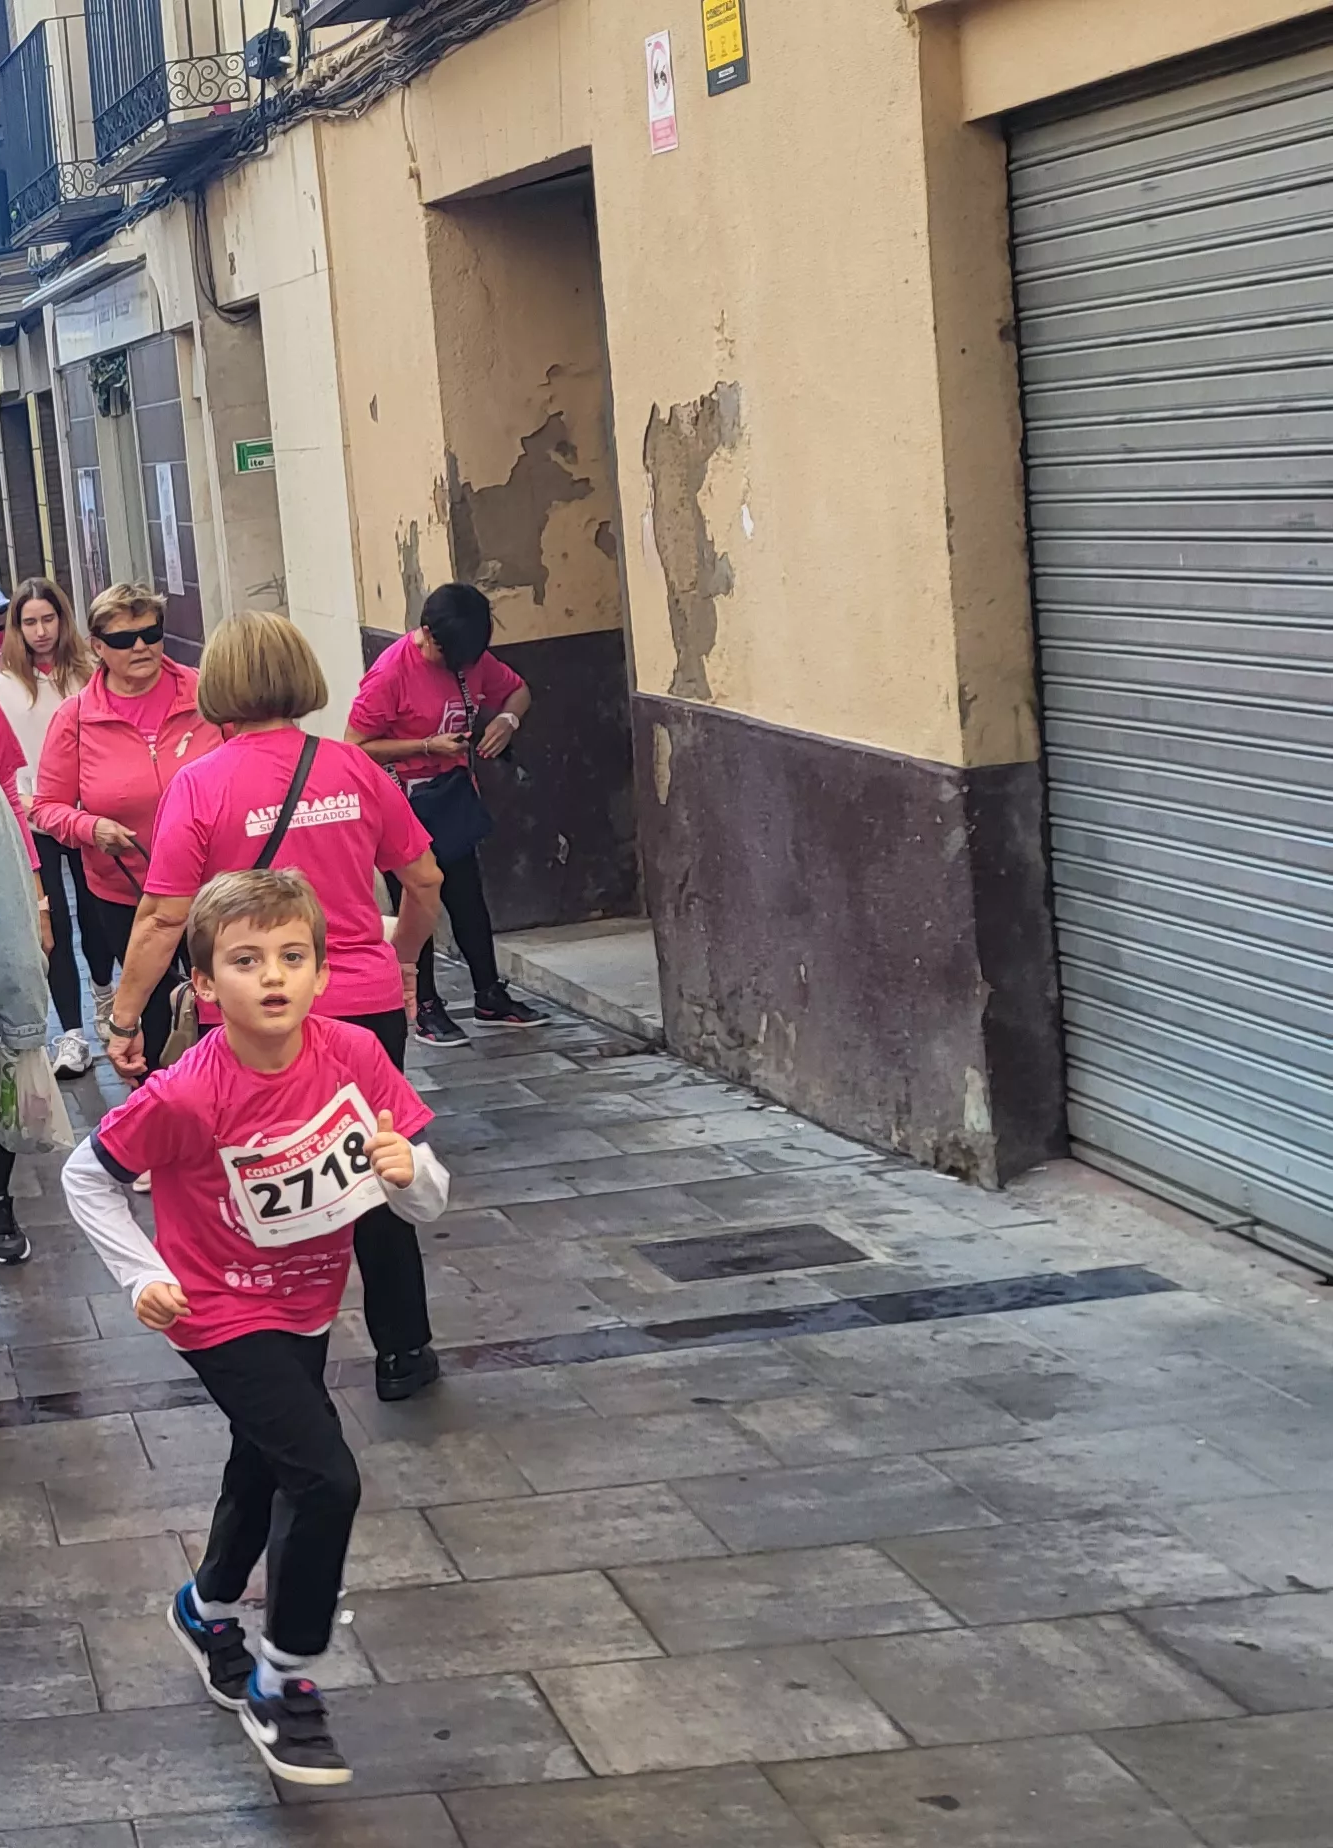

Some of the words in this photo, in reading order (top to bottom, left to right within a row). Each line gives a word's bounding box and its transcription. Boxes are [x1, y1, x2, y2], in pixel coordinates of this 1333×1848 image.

[245, 790, 360, 824] ALTORAGÓN
[259, 810, 352, 832] SUMERCADOS
[244, 1158, 302, 1178] CONTRA
[301, 1148, 318, 1162] EL
[316, 1113, 355, 1151] CÁNCER
[285, 1133, 322, 1159] HUESCA
[249, 1131, 371, 1218] 2718
